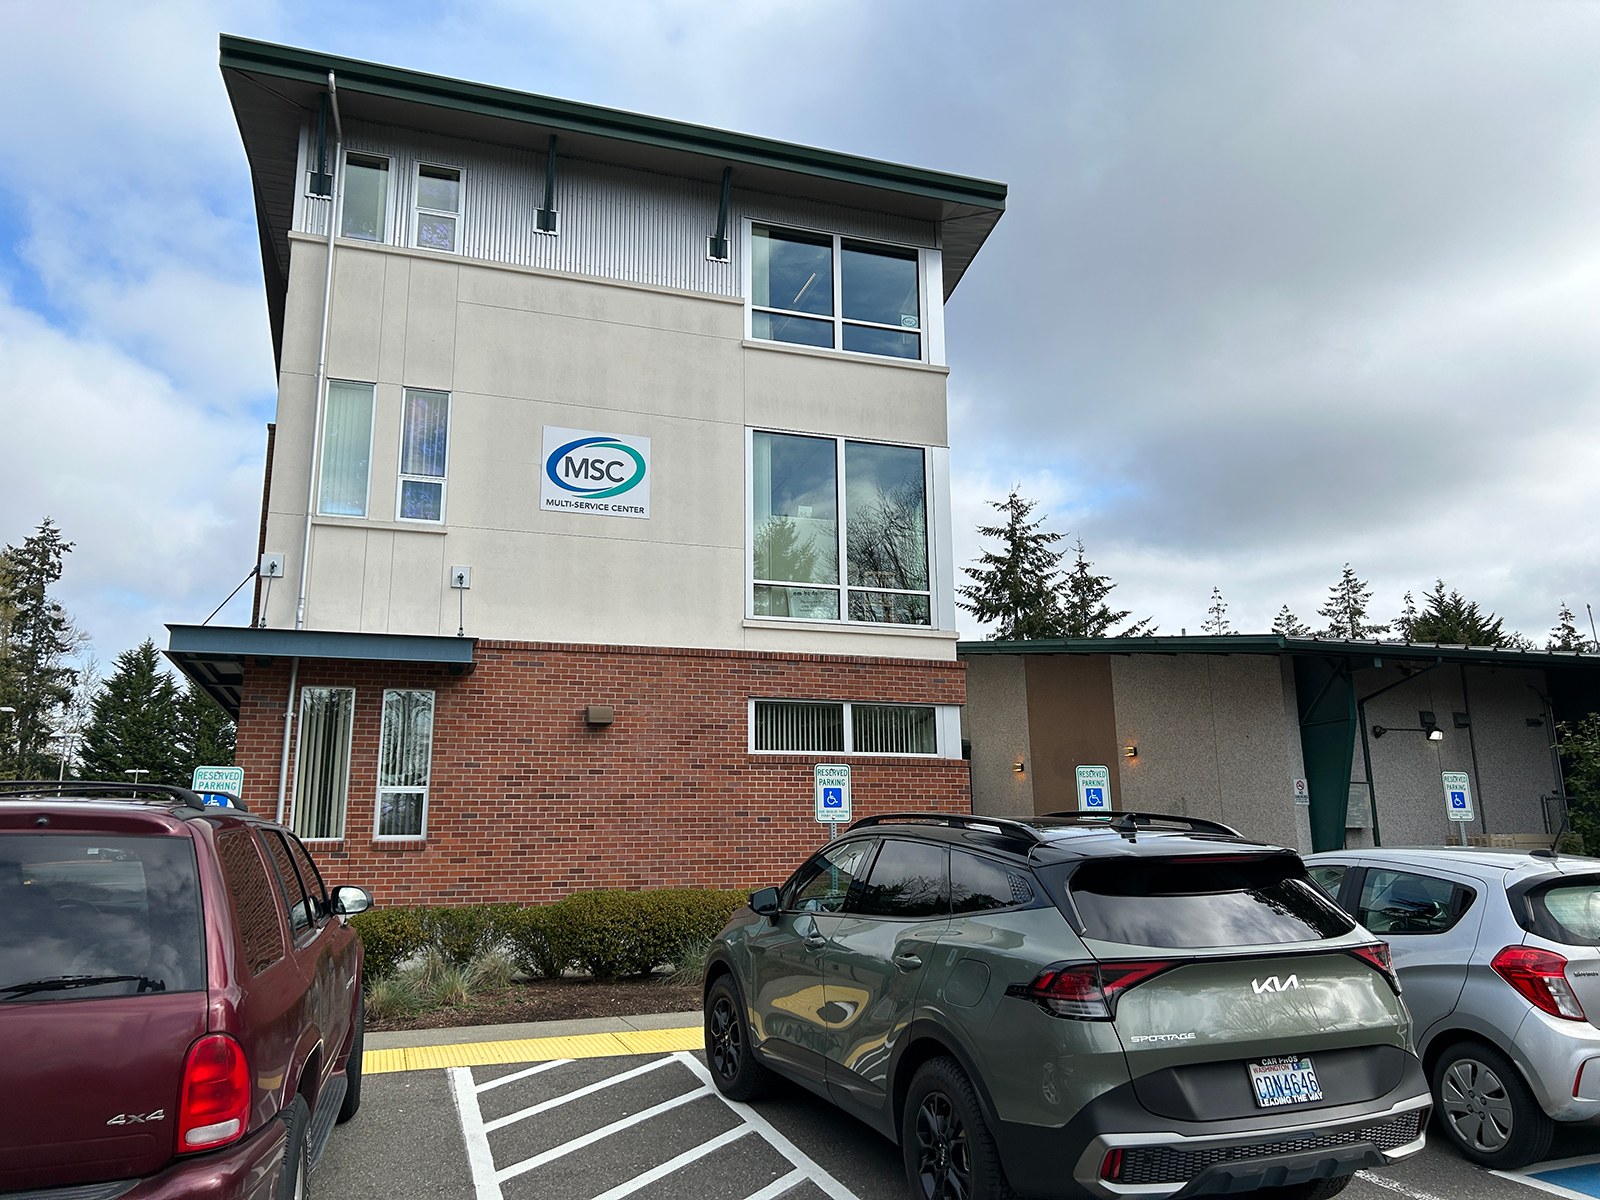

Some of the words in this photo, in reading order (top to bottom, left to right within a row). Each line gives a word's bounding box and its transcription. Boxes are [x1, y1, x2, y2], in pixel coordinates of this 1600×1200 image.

[564, 456, 625, 483] MSC
[546, 498, 609, 511] MULTI-SERVICE
[611, 504, 645, 514] CENTER
[198, 771, 240, 781] RESERVED
[817, 768, 848, 777] RESERVED
[1079, 770, 1106, 778] RESERVED
[819, 778, 846, 787] PARKING
[1082, 779, 1105, 787] PARKING
[1443, 775, 1467, 783] RESERVED
[198, 781, 237, 791] PARKING
[1446, 783, 1466, 791] PARKING
[1251, 974, 1299, 994] KIA
[1130, 1032, 1196, 1043] SPORTAGE
[1261, 1057, 1278, 1066] CAR
[1252, 1063, 1290, 1074] WASHINGTON
[1255, 1071, 1319, 1099] CDN4646
[1260, 1095, 1293, 1107] LEADING
[1292, 1093, 1308, 1103] THE
[1308, 1091, 1323, 1101] WAY
